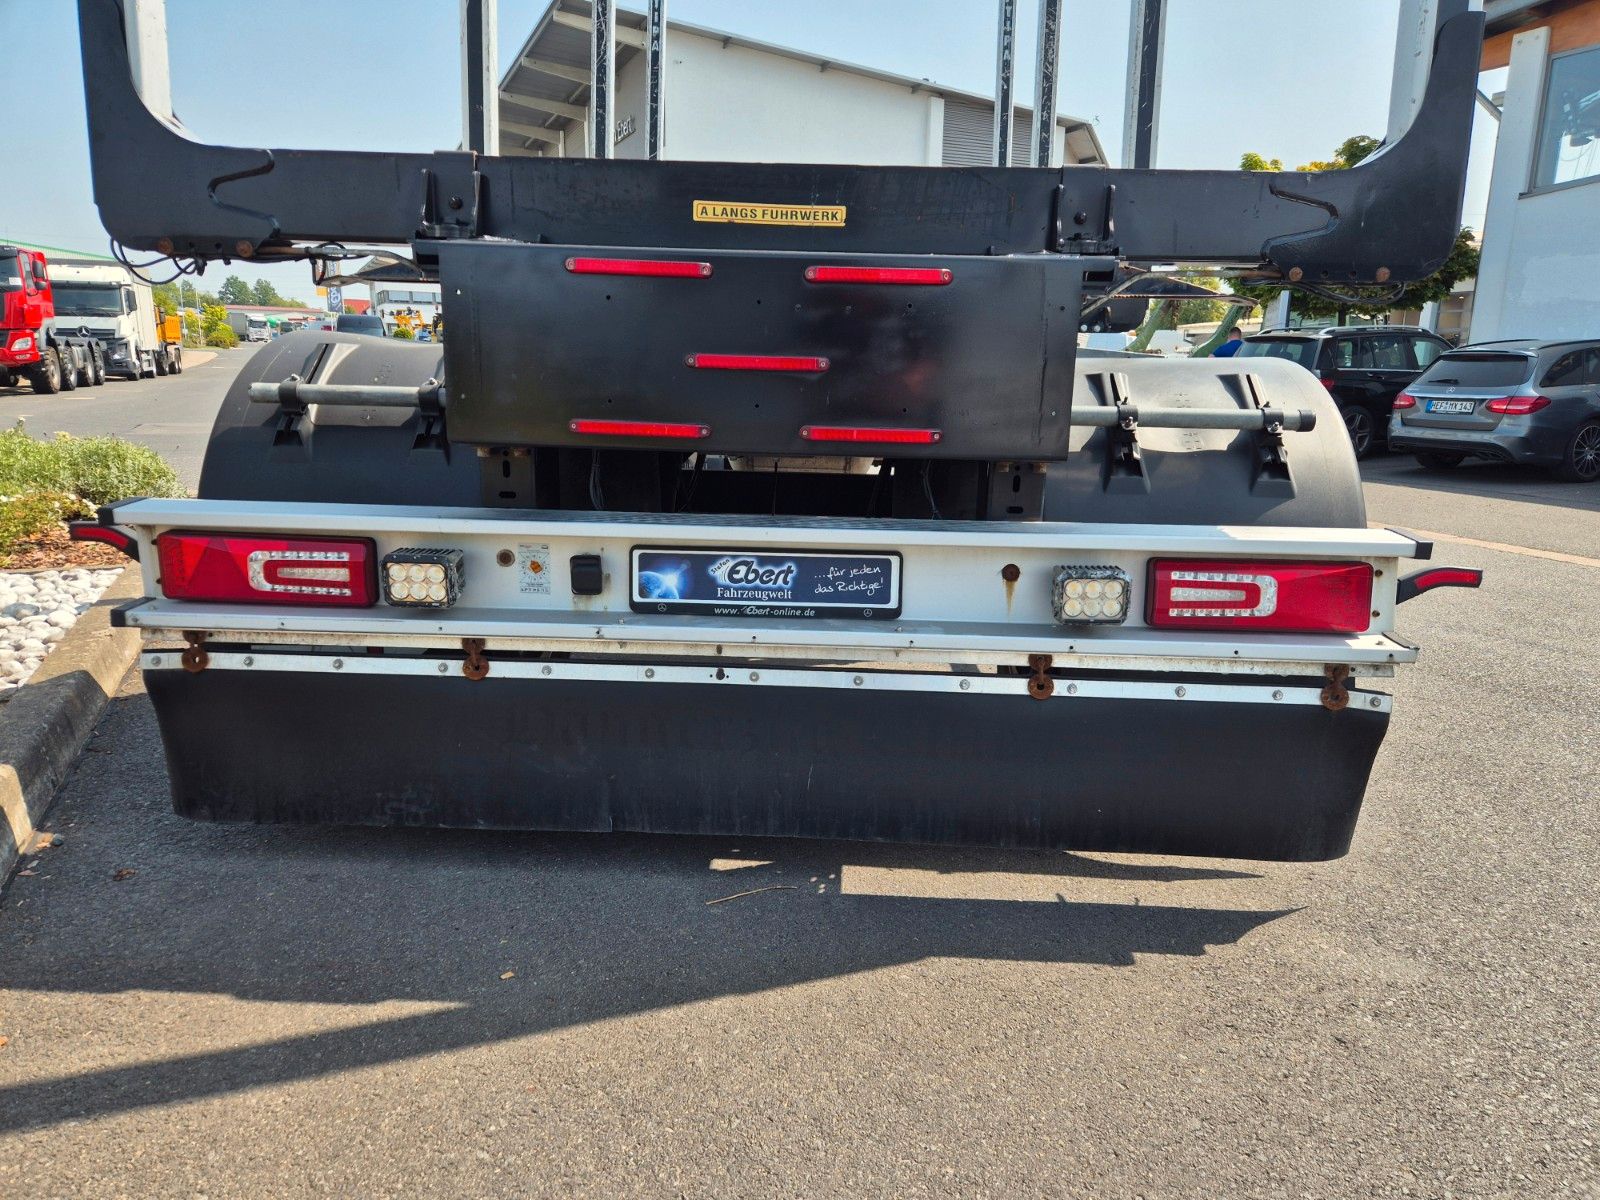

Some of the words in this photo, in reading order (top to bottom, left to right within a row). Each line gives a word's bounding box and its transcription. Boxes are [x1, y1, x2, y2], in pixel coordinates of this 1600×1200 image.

[700, 206, 708, 216] A
[712, 206, 757, 219] LANGS
[761, 208, 839, 221] FUHRWERK
[727, 559, 794, 586] Ebert
[849, 563, 881, 578] jeden
[716, 587, 793, 601] Fahrzeugwelt
[814, 583, 834, 594] das
